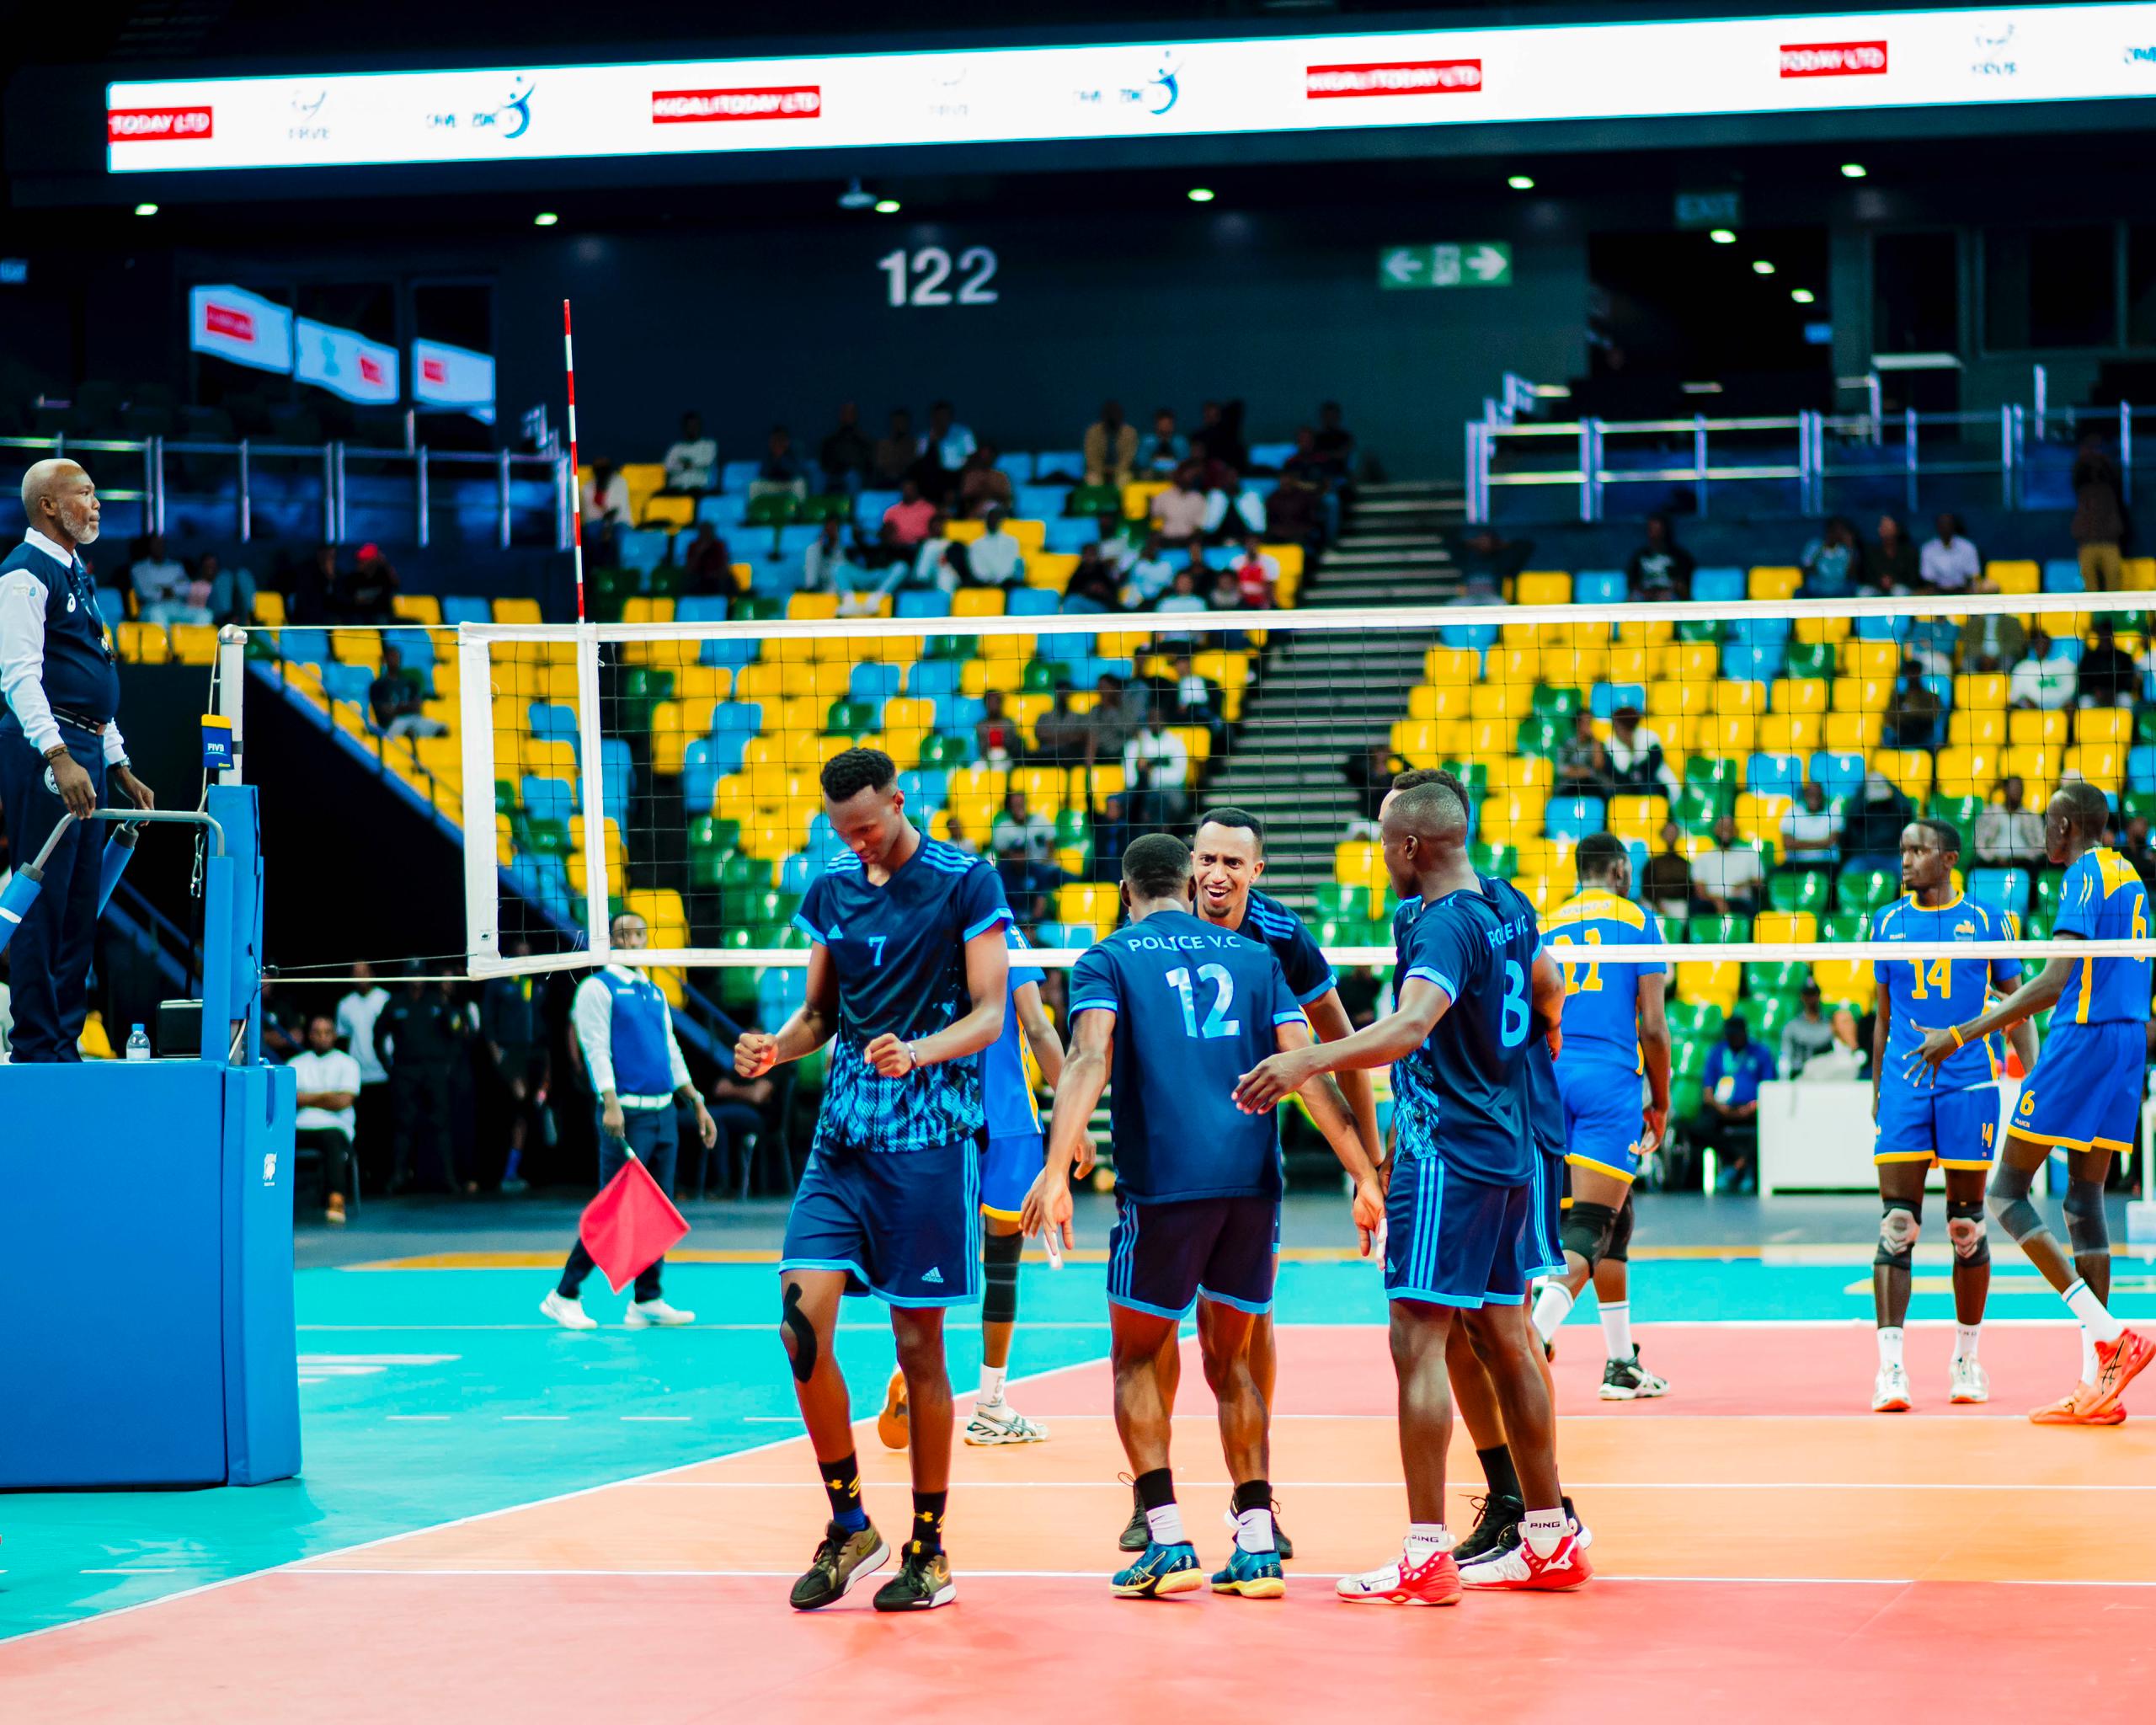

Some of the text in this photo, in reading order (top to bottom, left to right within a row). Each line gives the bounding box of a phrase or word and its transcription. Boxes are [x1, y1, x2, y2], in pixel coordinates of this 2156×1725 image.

[109, 112, 210, 135] TODAY LTD
[877, 246, 998, 307] 122
[207, 743, 225, 752] FIVB
[868, 936, 887, 966] 7
[1127, 935, 1241, 952] POLICE V.C
[1908, 958, 1951, 1000] 14
[1165, 963, 1241, 1039] 12
[2020, 1090, 2036, 1116] 6
[1529, 1520, 1561, 1529] PING
